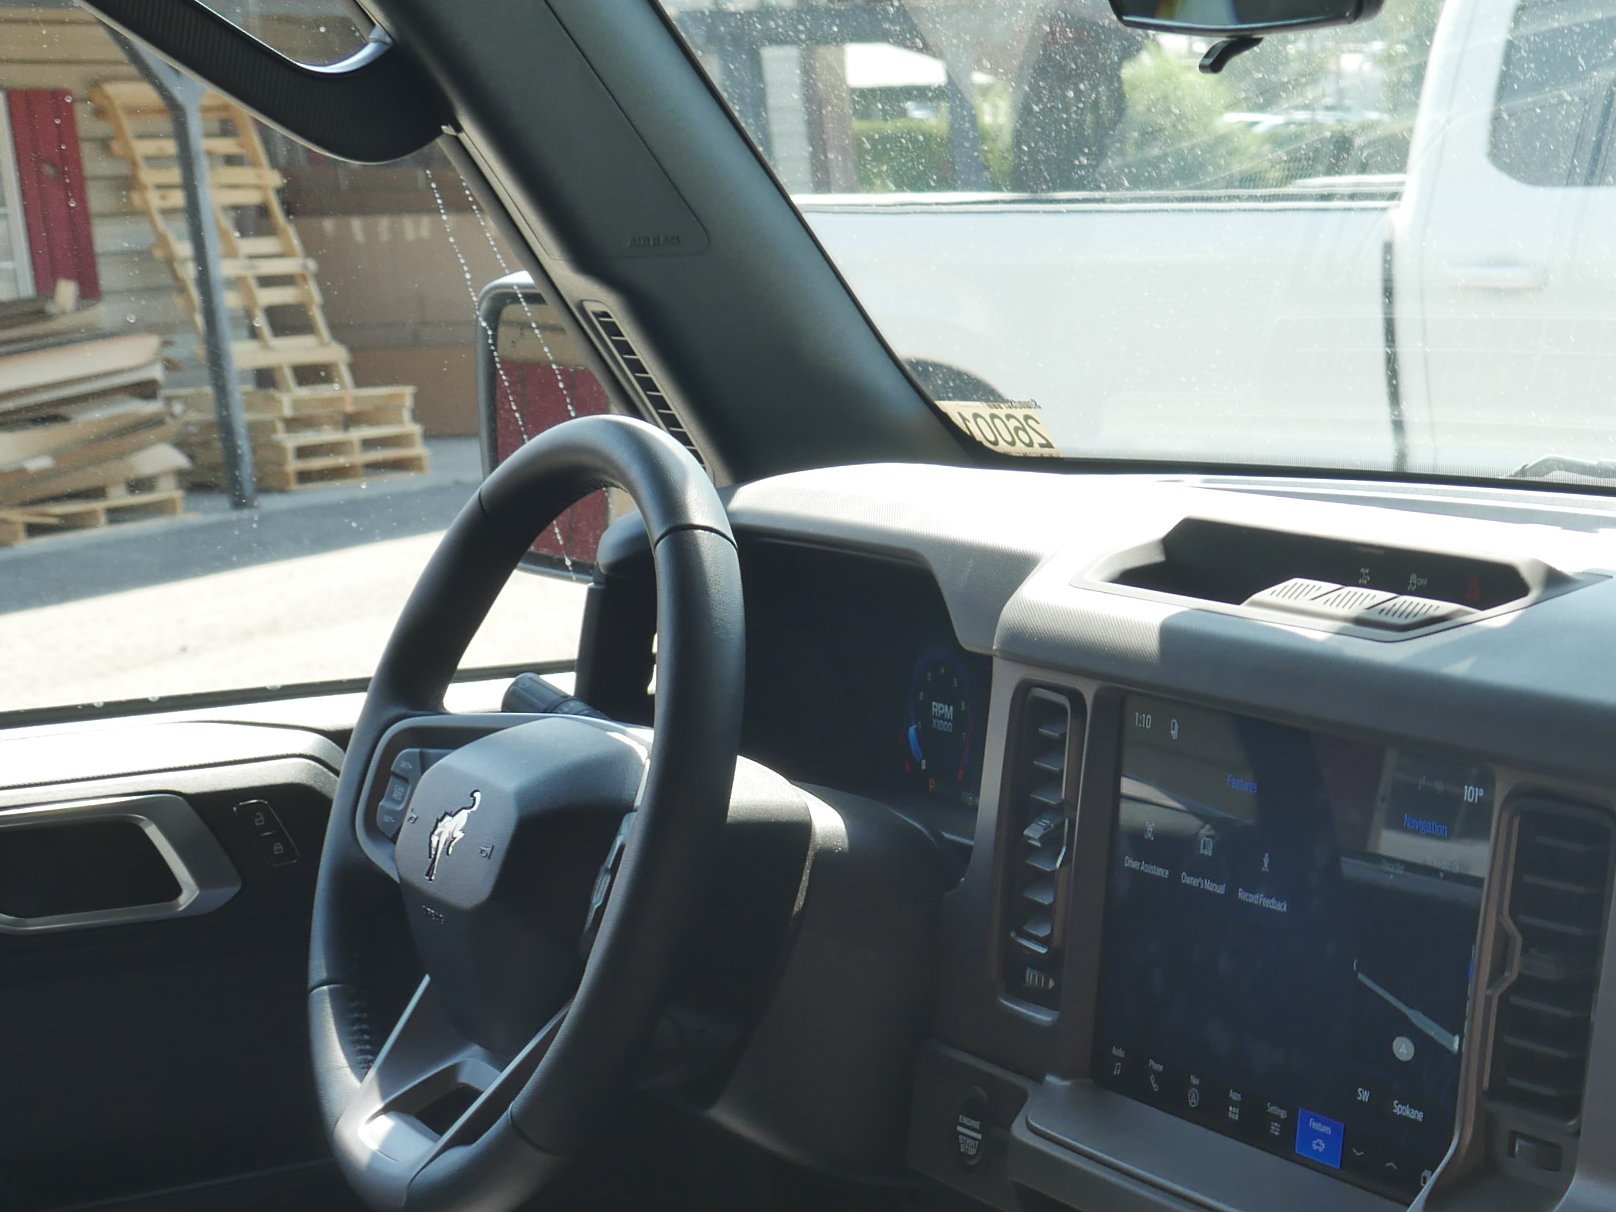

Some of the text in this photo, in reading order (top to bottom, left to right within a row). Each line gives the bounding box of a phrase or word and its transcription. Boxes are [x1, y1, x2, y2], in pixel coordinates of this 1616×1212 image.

[931, 701, 953, 720] RPM
[1135, 712, 1152, 729] 1:10
[1226, 774, 1258, 794] Features
[1403, 813, 1448, 837] Navigation
[1124, 855, 1170, 879] Driver Assistance
[1181, 872, 1226, 895] Owner's Manual
[1238, 888, 1288, 913] Record Feedback
[1357, 1087, 1370, 1102] SW
[1266, 1102, 1288, 1120] Settings
[1393, 1100, 1424, 1122] Spokane
[1309, 1118, 1332, 1135] Features
